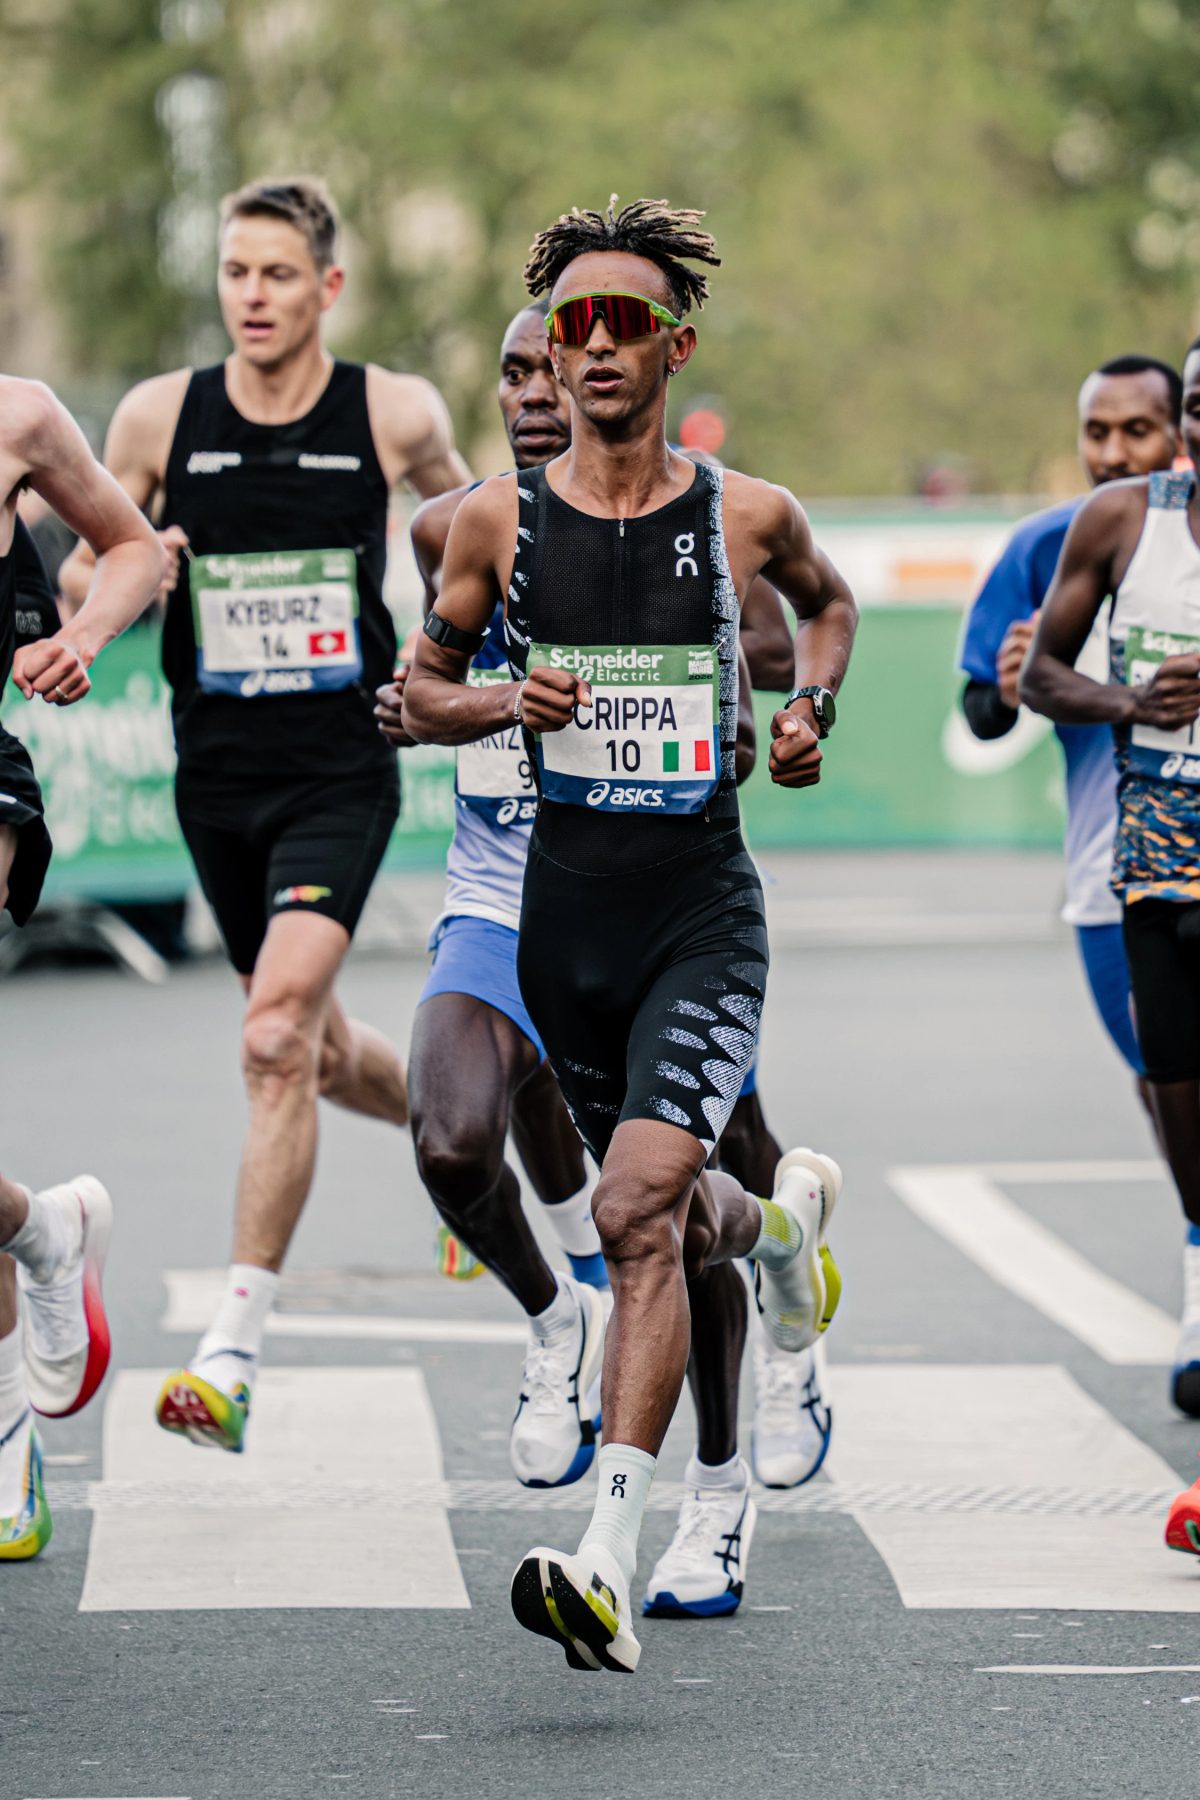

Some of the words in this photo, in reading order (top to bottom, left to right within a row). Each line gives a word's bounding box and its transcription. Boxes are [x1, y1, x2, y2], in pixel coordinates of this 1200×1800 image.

[226, 596, 321, 626] KYBURZ
[262, 634, 289, 659] 14
[549, 647, 664, 669] Schneider
[597, 669, 660, 681] Electric
[573, 697, 678, 731] CRIPPA
[606, 739, 641, 772] 10
